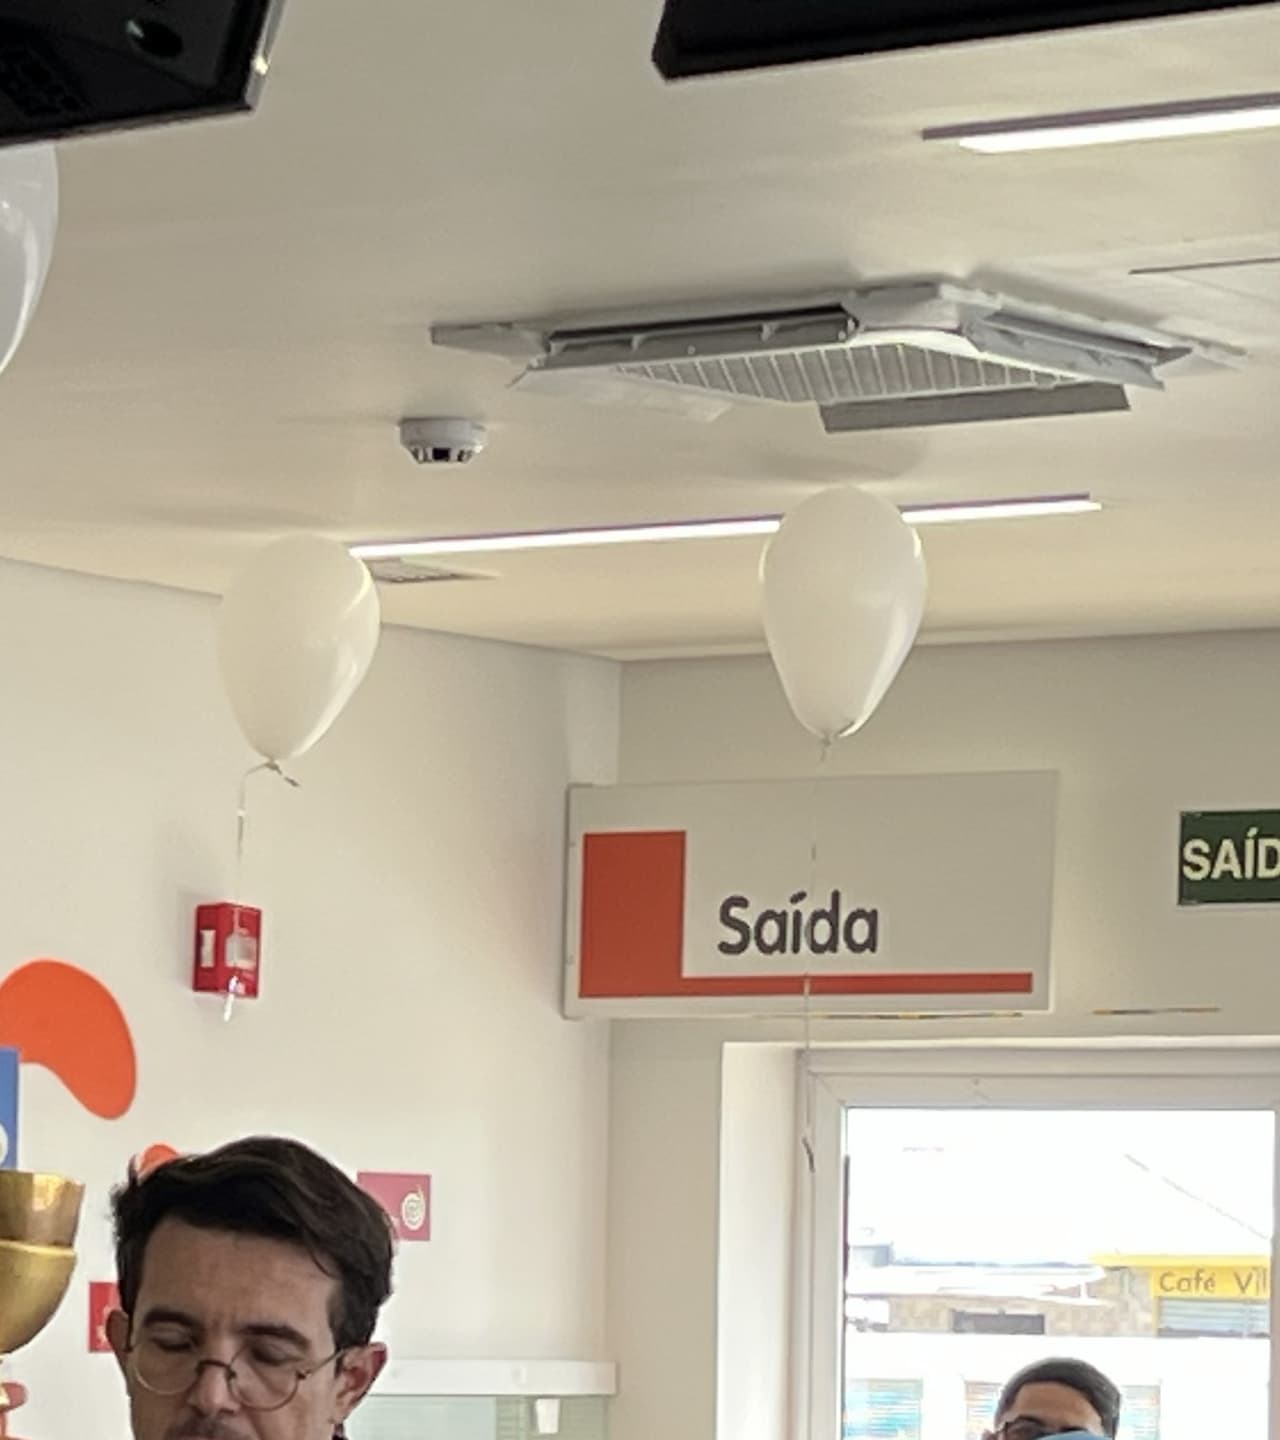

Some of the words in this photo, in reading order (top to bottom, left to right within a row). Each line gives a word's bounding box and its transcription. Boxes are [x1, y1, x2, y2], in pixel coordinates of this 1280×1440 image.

[717, 889, 878, 955] Saída
[1159, 1268, 1216, 1293] Café
[1233, 1266, 1269, 1296] Vil
